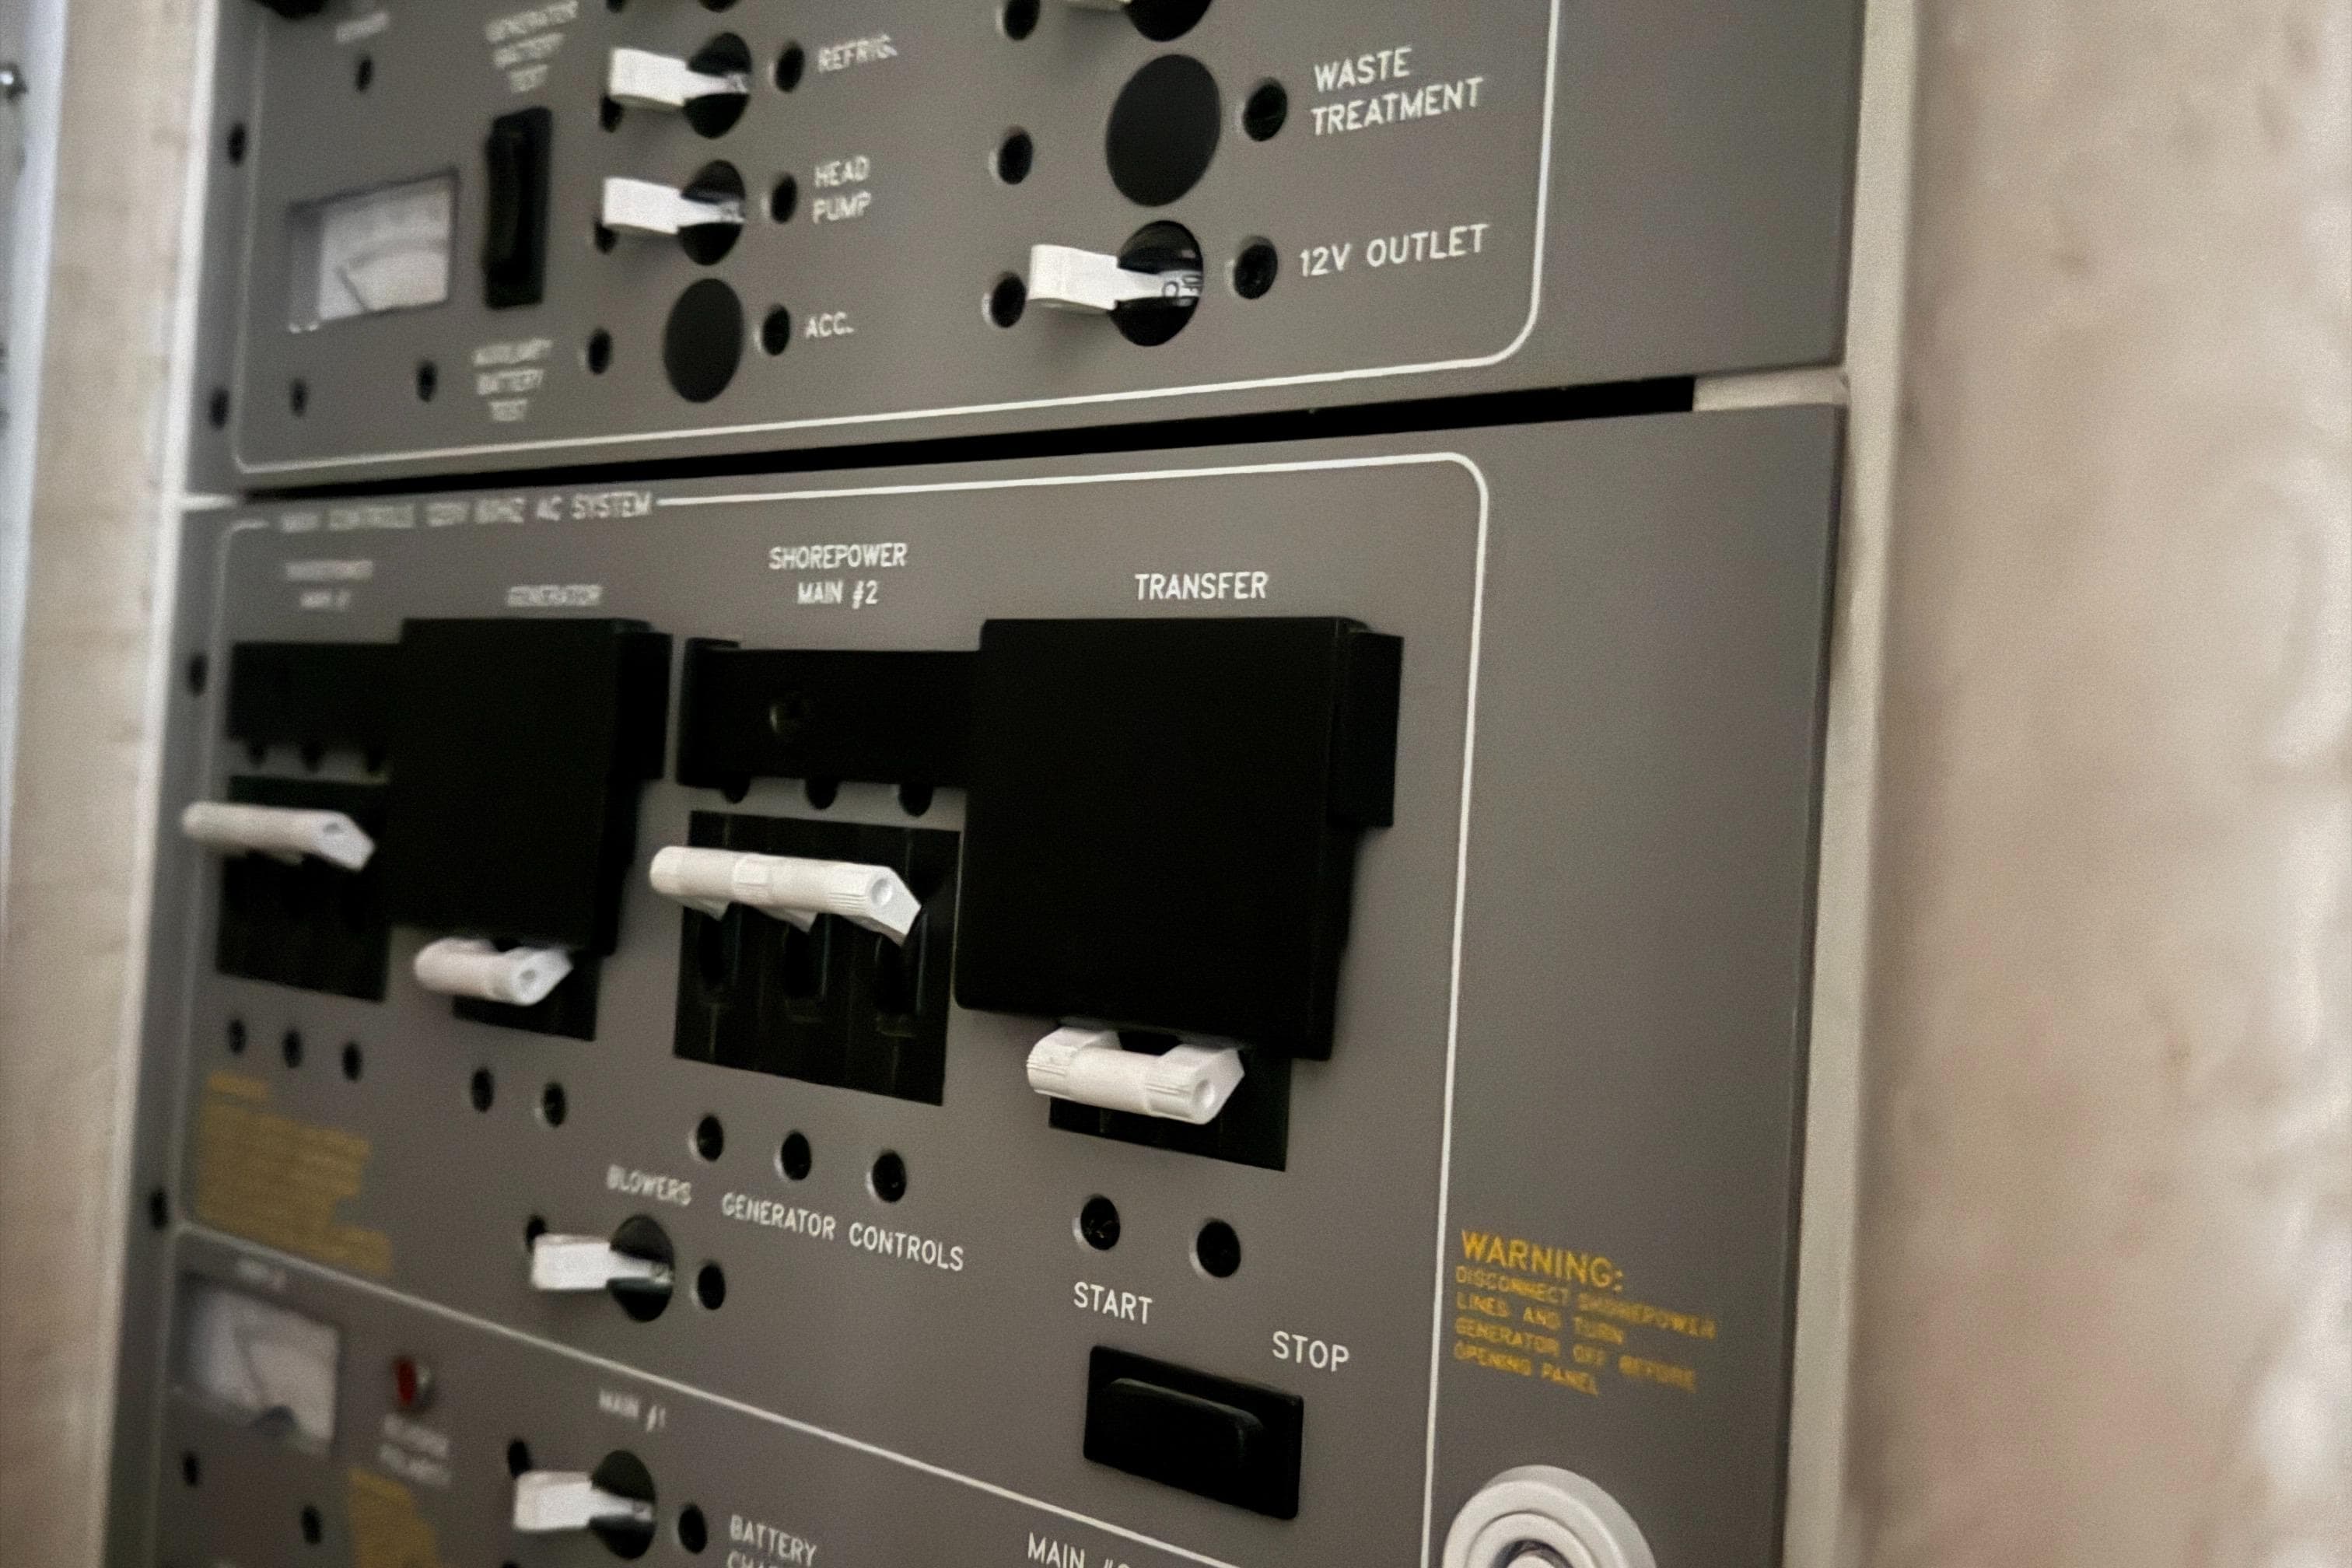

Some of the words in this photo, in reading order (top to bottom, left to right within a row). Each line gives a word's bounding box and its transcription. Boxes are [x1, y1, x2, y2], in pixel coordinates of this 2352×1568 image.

[1314, 47, 1411, 91] WASTE
[1311, 77, 1482, 135] TREATMENT
[815, 156, 870, 186] HEAD
[813, 191, 871, 222] PUMP
[1300, 243, 1351, 276] 12V
[1367, 223, 1488, 267] OUTLET
[573, 491, 651, 519] SYSTEM
[770, 542, 907, 569] SHOREPOWER
[798, 581, 843, 604] MAIN
[852, 580, 877, 609] #2
[1135, 571, 1269, 600] TRANSFER
[607, 1165, 691, 1206] BLOWERS
[723, 1193, 836, 1240] GENERATOR
[849, 1222, 963, 1271] CONTROLS
[1461, 1230, 1624, 1293] WARNING:
[1074, 1282, 1152, 1324] START
[1273, 1331, 1349, 1371] STOP
[730, 1514, 817, 1566] BATTERY
[1028, 1533, 1085, 1568] MAIN
